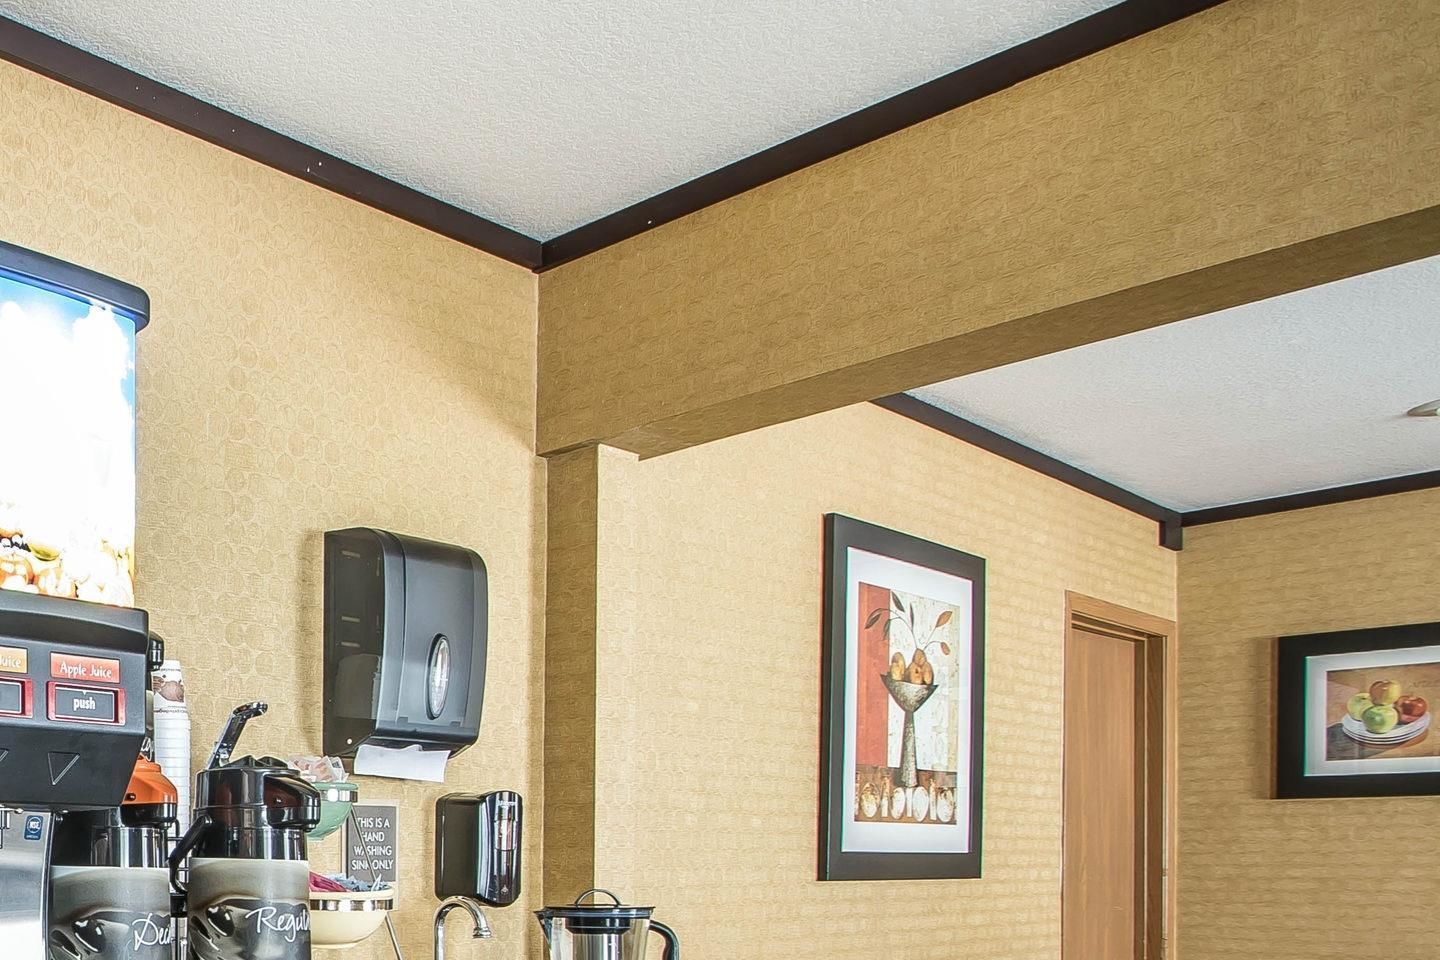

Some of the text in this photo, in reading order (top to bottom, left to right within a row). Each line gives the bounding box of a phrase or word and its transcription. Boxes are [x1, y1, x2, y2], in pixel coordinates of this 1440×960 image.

[60, 662, 113, 678] Apple Juice
[73, 698, 96, 711] push
[375, 818, 383, 828] IS
[383, 819, 391, 828] A
[372, 859, 394, 870] ONLY
